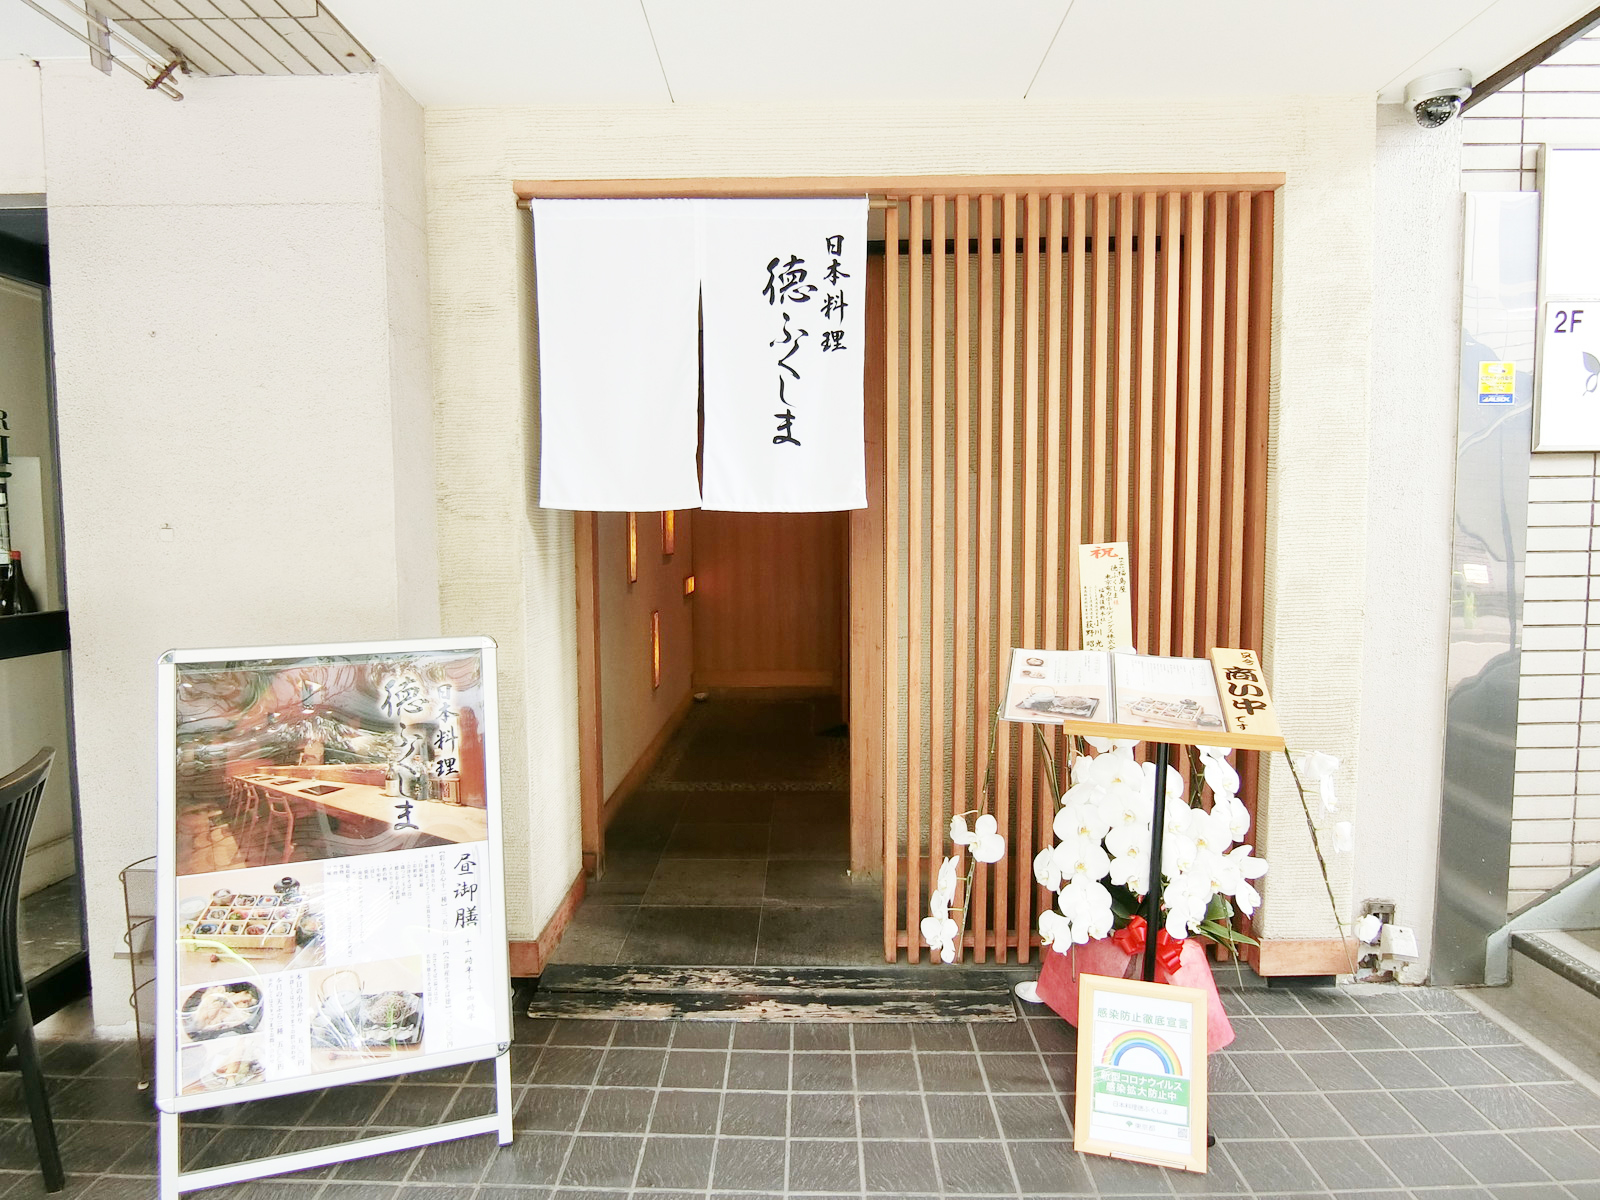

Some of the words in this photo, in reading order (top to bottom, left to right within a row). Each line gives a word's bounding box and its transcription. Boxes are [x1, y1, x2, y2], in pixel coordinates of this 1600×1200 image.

[820, 234, 850, 352] 日本料理
[1554, 310, 1584, 333] 2F
[762, 254, 818, 447] 徳ふくしま
[1089, 546, 1119, 559] 祝
[1105, 574, 1116, 652] 東京電力ホールディングス株式会
[381, 676, 429, 831] 徳ふくしま
[434, 683, 459, 777] 日本料理
[453, 853, 479, 929] 昼御膳
[1097, 1007, 1189, 1029] 感染防止徹底宣言
[1100, 1069, 1183, 1092] 新型コロナウイルス
[1106, 1081, 1177, 1101] 感染拡大防止中
